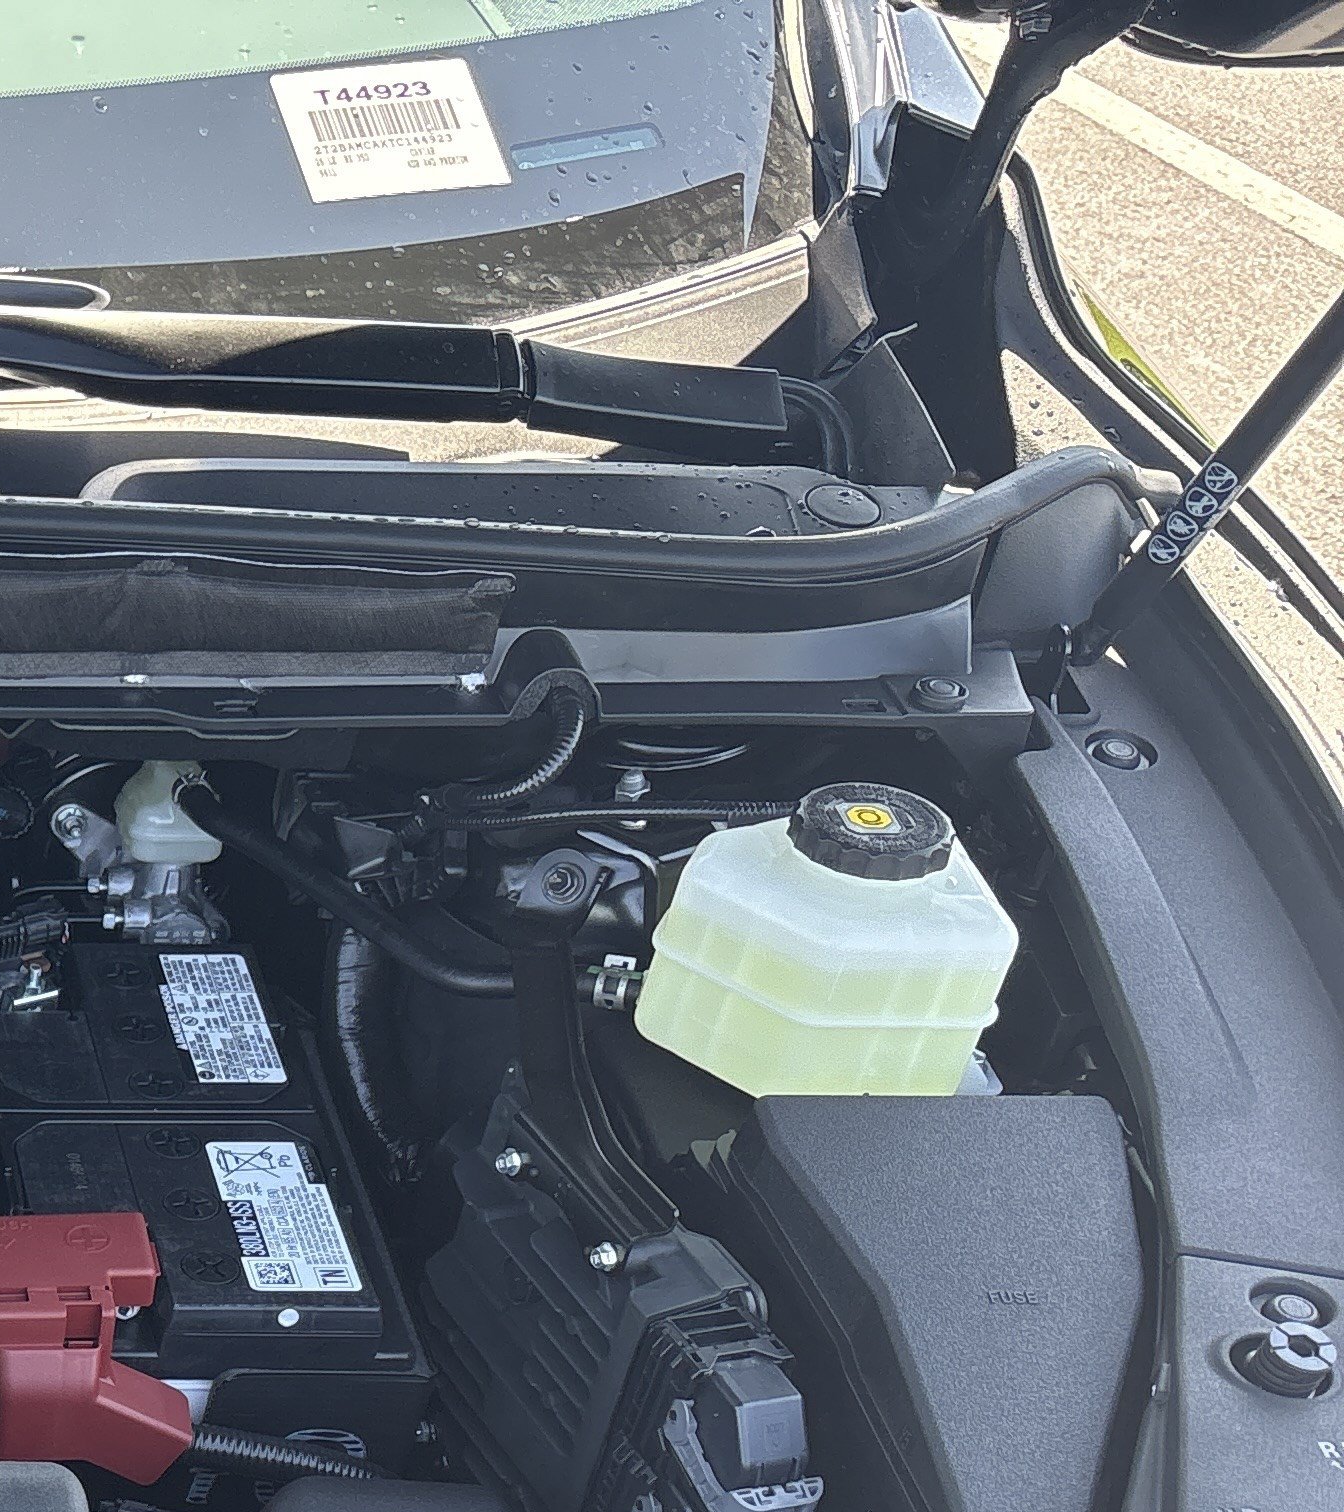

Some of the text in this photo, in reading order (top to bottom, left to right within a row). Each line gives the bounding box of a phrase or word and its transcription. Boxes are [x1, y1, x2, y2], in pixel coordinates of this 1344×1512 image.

[313, 81, 432, 105] T44923
[319, 1268, 349, 1285] TN
[987, 1290, 1039, 1305] FUSE
